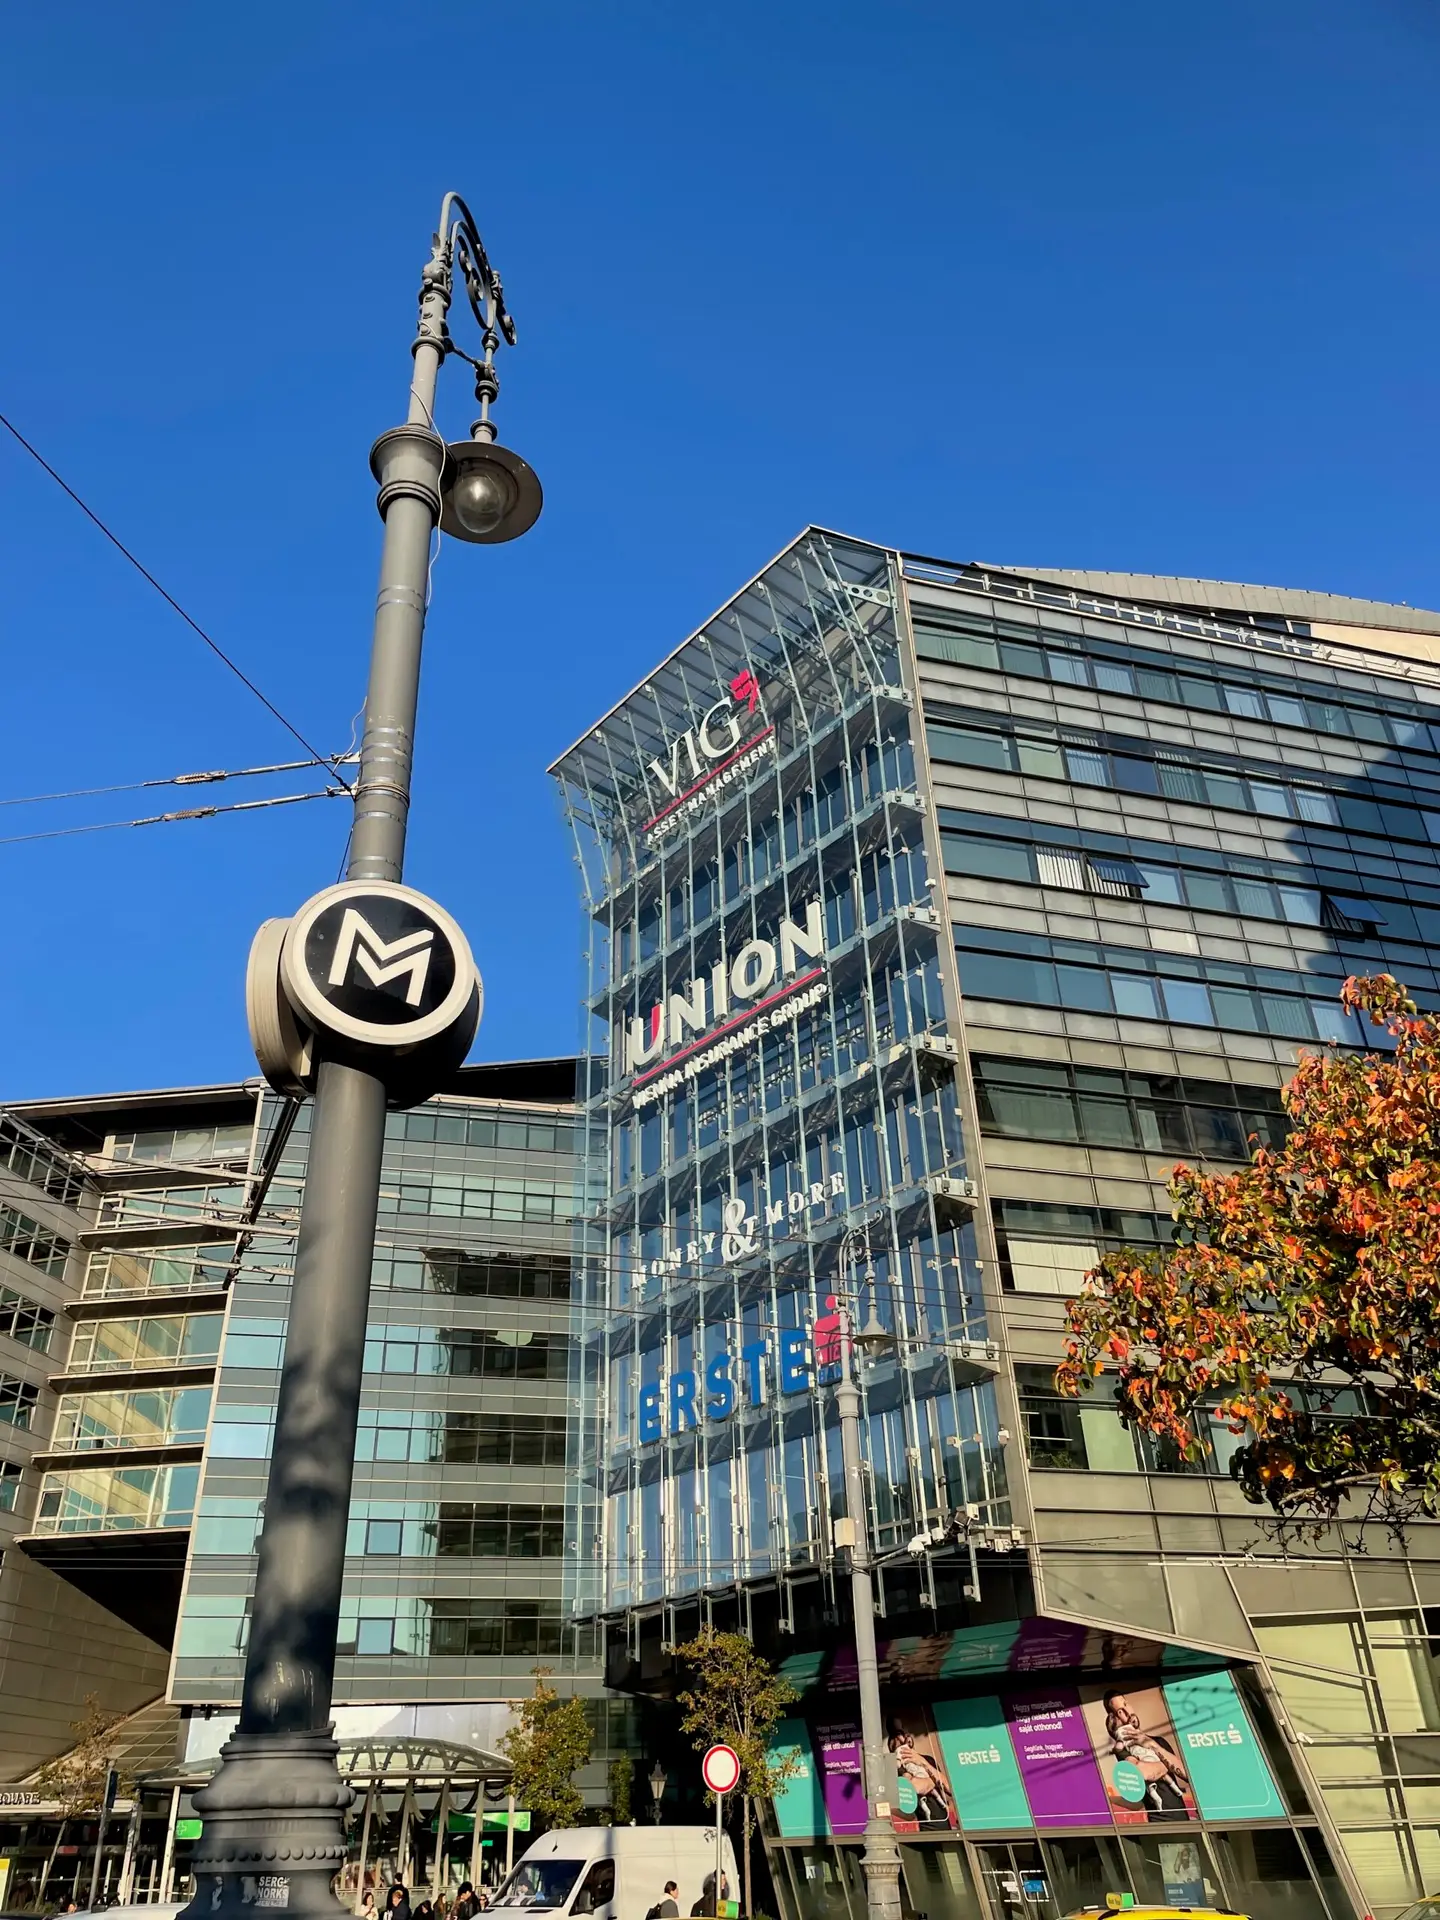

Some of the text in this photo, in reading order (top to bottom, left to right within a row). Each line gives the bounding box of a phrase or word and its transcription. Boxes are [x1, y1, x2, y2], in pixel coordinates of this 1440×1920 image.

[647, 696, 742, 797] VIG
[647, 735, 776, 846] ASSET MANAGEMENT
[627, 900, 824, 1070] UNION
[770, 982, 830, 1028] GROUP
[631, 1171, 845, 1289] MONEY & MORE
[639, 1328, 810, 1446] ERSTE
[957, 1750, 990, 1765] ERSTE
[1186, 1730, 1229, 1748] ERSTE
[0, 1791, 40, 1805] QUARE
